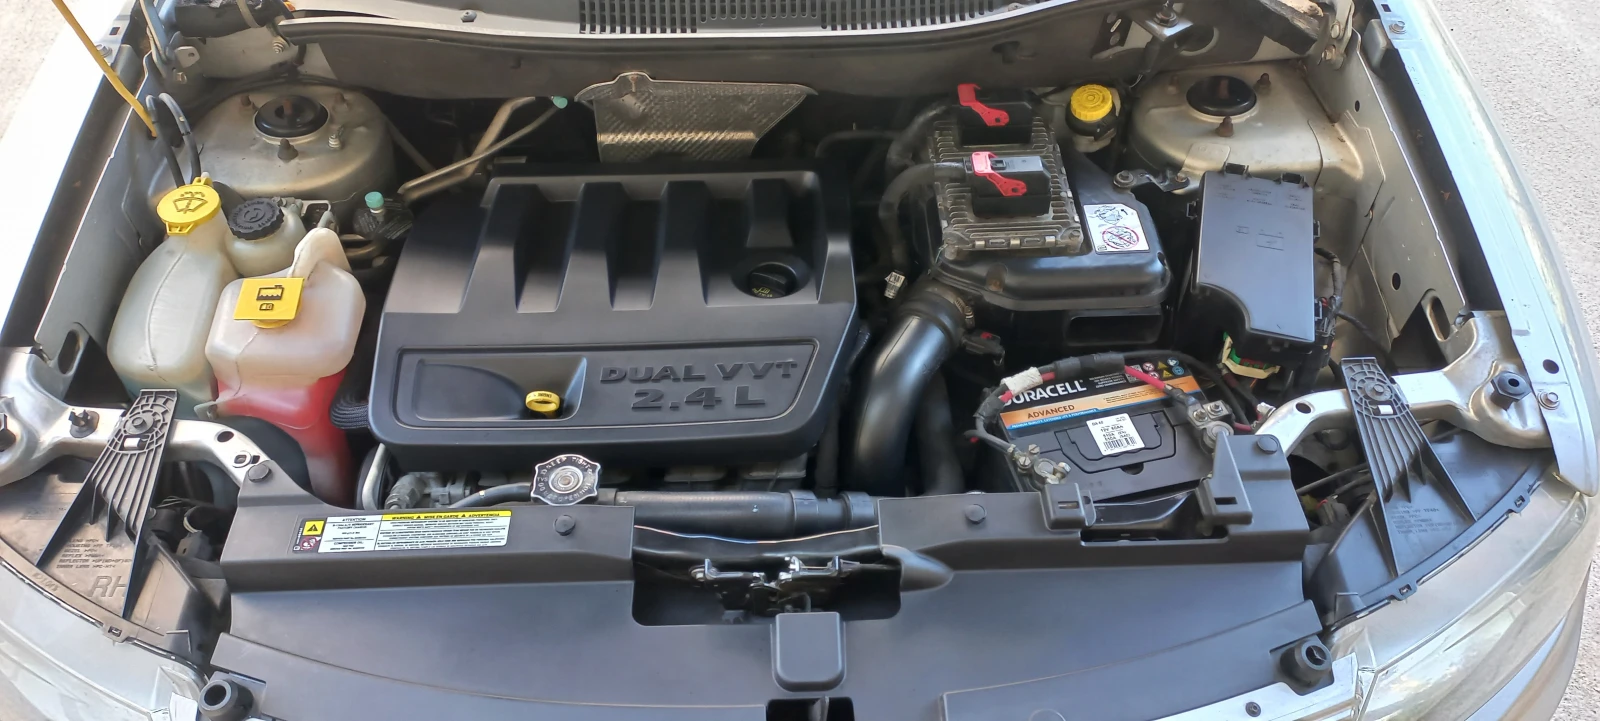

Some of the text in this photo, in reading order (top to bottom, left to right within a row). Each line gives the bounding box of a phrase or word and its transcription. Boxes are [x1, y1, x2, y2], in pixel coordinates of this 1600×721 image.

[600, 358, 798, 383] DUAL VVT
[1027, 404, 1075, 419] ADVANCED
[88, 575, 128, 598] RH
